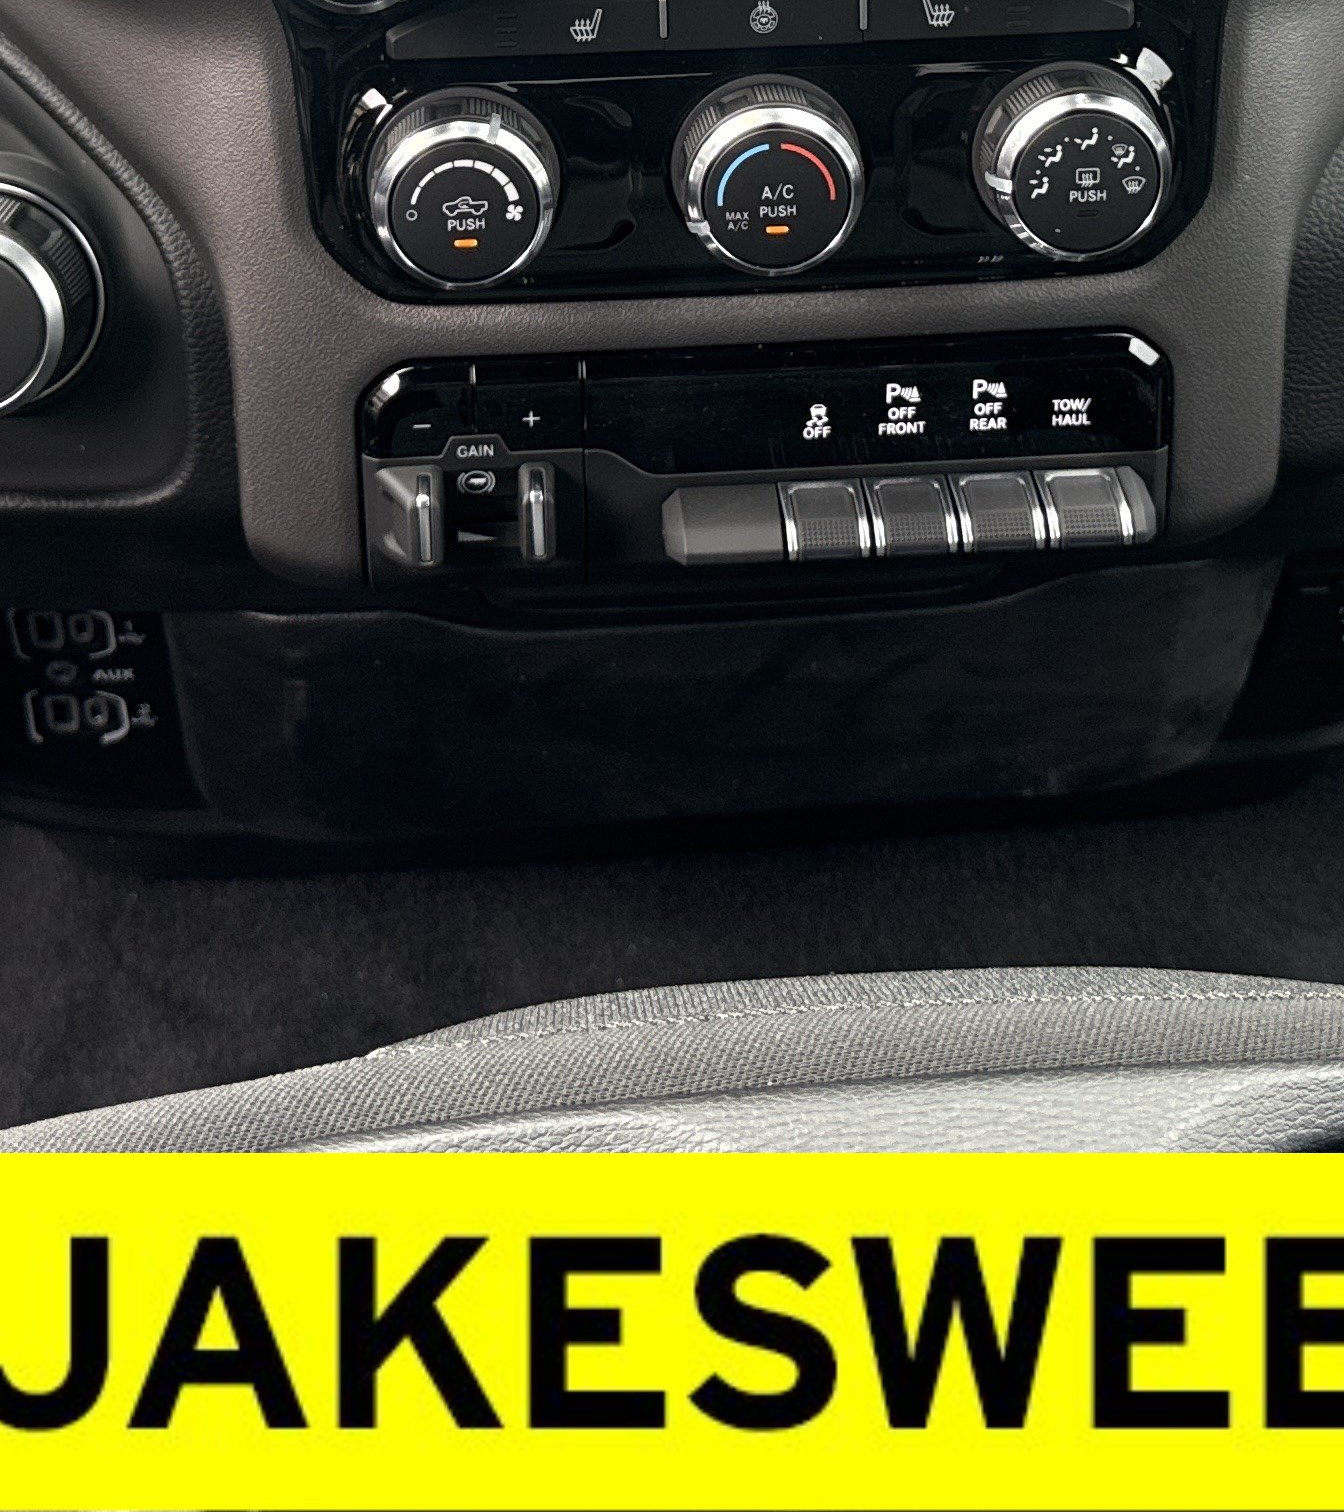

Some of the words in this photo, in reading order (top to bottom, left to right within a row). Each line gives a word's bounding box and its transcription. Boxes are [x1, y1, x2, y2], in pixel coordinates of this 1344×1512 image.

[761, 185, 794, 200] A/C
[1069, 190, 1107, 202] PUSH
[725, 211, 750, 221] MAX
[759, 205, 797, 218] PUSH
[447, 219, 486, 232] PUSH
[727, 220, 749, 231] A/C
[974, 402, 1003, 416] OFF
[1052, 397, 1092, 412] TOW/
[887, 406, 916, 421] OFF
[1052, 412, 1092, 427] HAUL
[878, 420, 926, 436] FRONT
[969, 417, 1008, 432] REAR
[803, 426, 831, 439] OFF
[456, 444, 494, 458] GAIN
